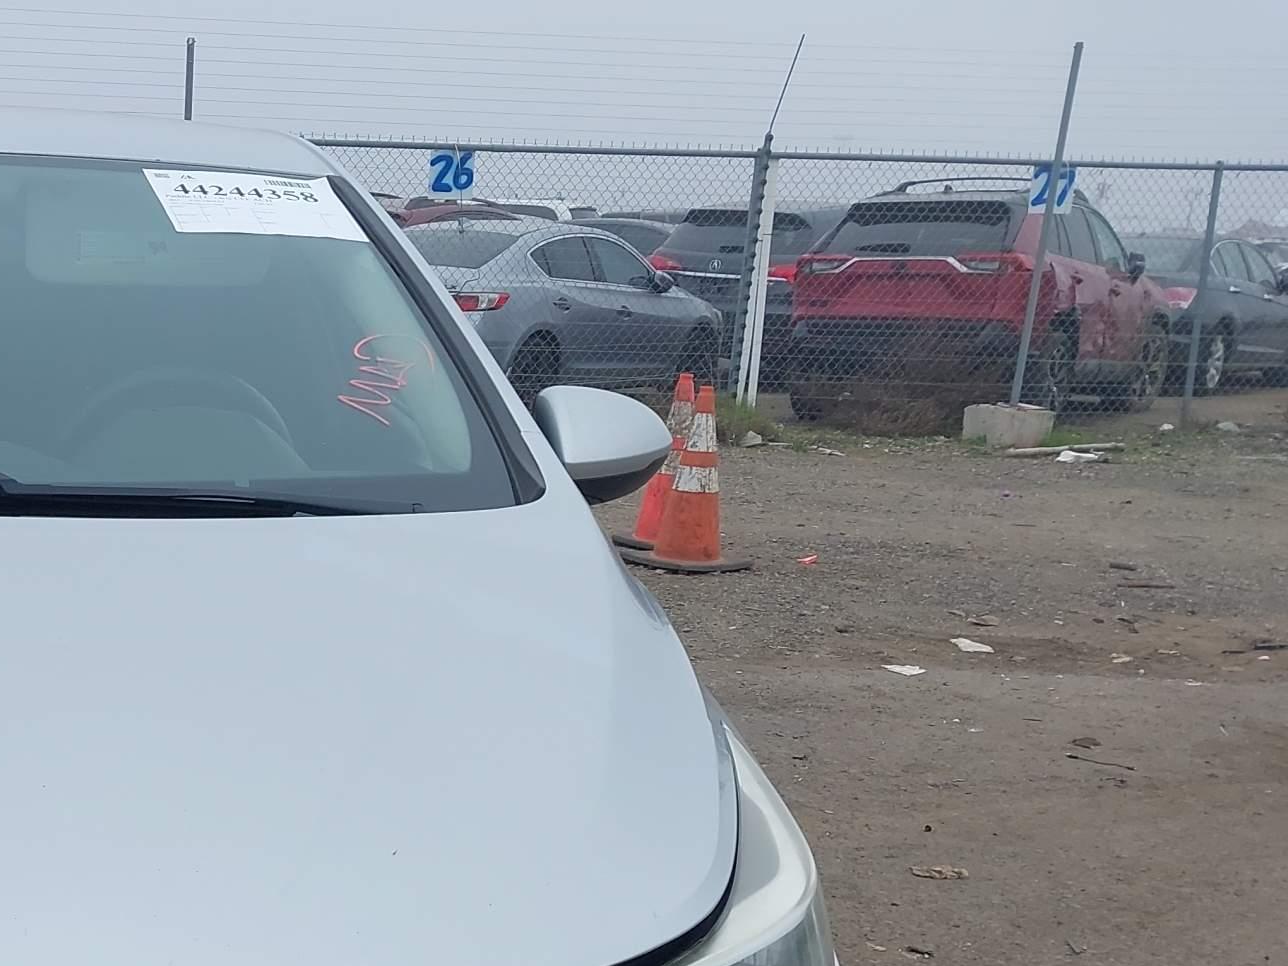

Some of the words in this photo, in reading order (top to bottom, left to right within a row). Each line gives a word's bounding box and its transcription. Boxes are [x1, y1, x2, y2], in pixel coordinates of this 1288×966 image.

[430, 152, 474, 192] 26
[1031, 162, 1076, 207] 27
[174, 183, 319, 203] 44244358
